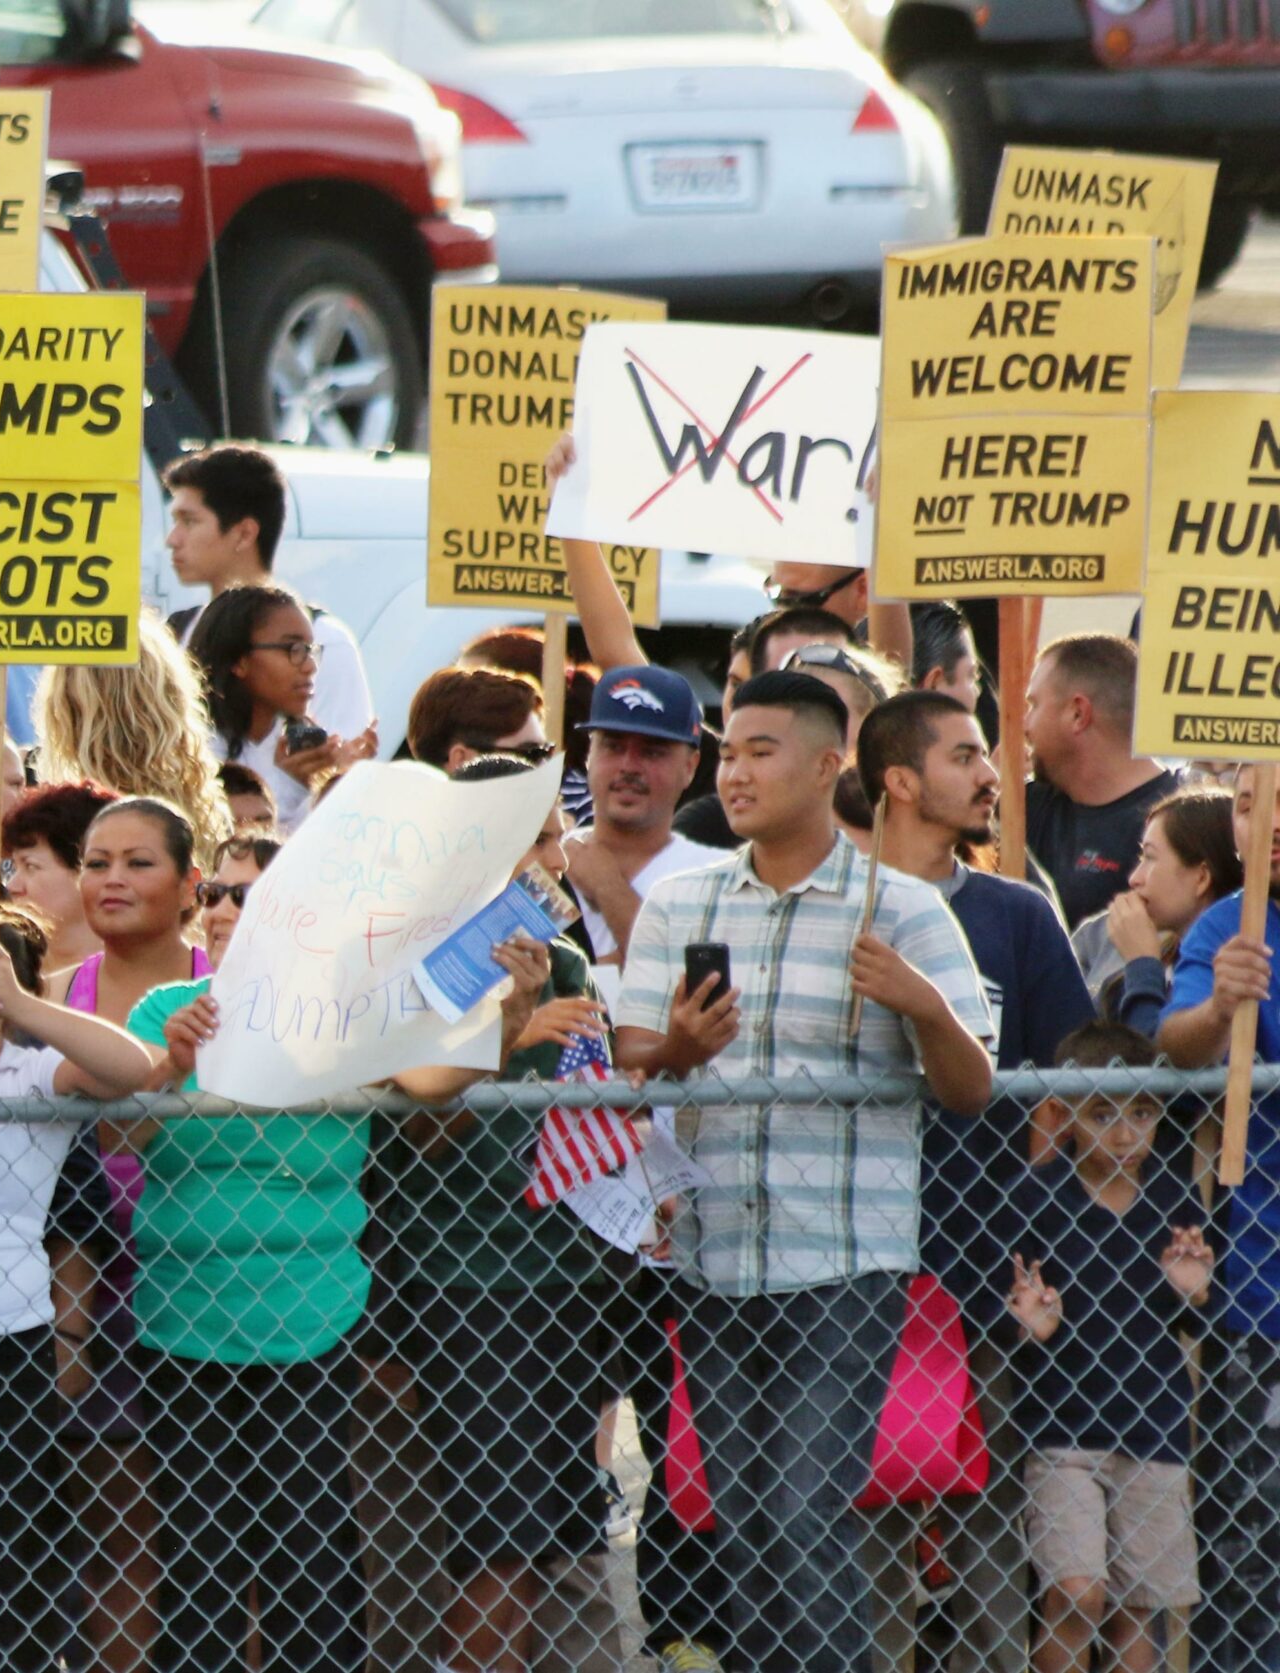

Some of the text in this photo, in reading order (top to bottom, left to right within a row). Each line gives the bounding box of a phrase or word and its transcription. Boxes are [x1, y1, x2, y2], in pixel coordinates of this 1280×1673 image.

[1013, 168, 1152, 210] UNMASK
[898, 258, 1138, 300] IMMIGRANTS
[970, 300, 1061, 339] ARE
[448, 349, 578, 383] DONAL
[911, 354, 1131, 399] WELCOME
[626, 361, 877, 523] War!
[940, 435, 1088, 480] HERE!
[499, 462, 547, 489] DE
[913, 492, 1130, 528] NOT TRUMP
[921, 557, 1099, 584] ANSWERLA.ORG
[1163, 651, 1280, 699] ILLE
